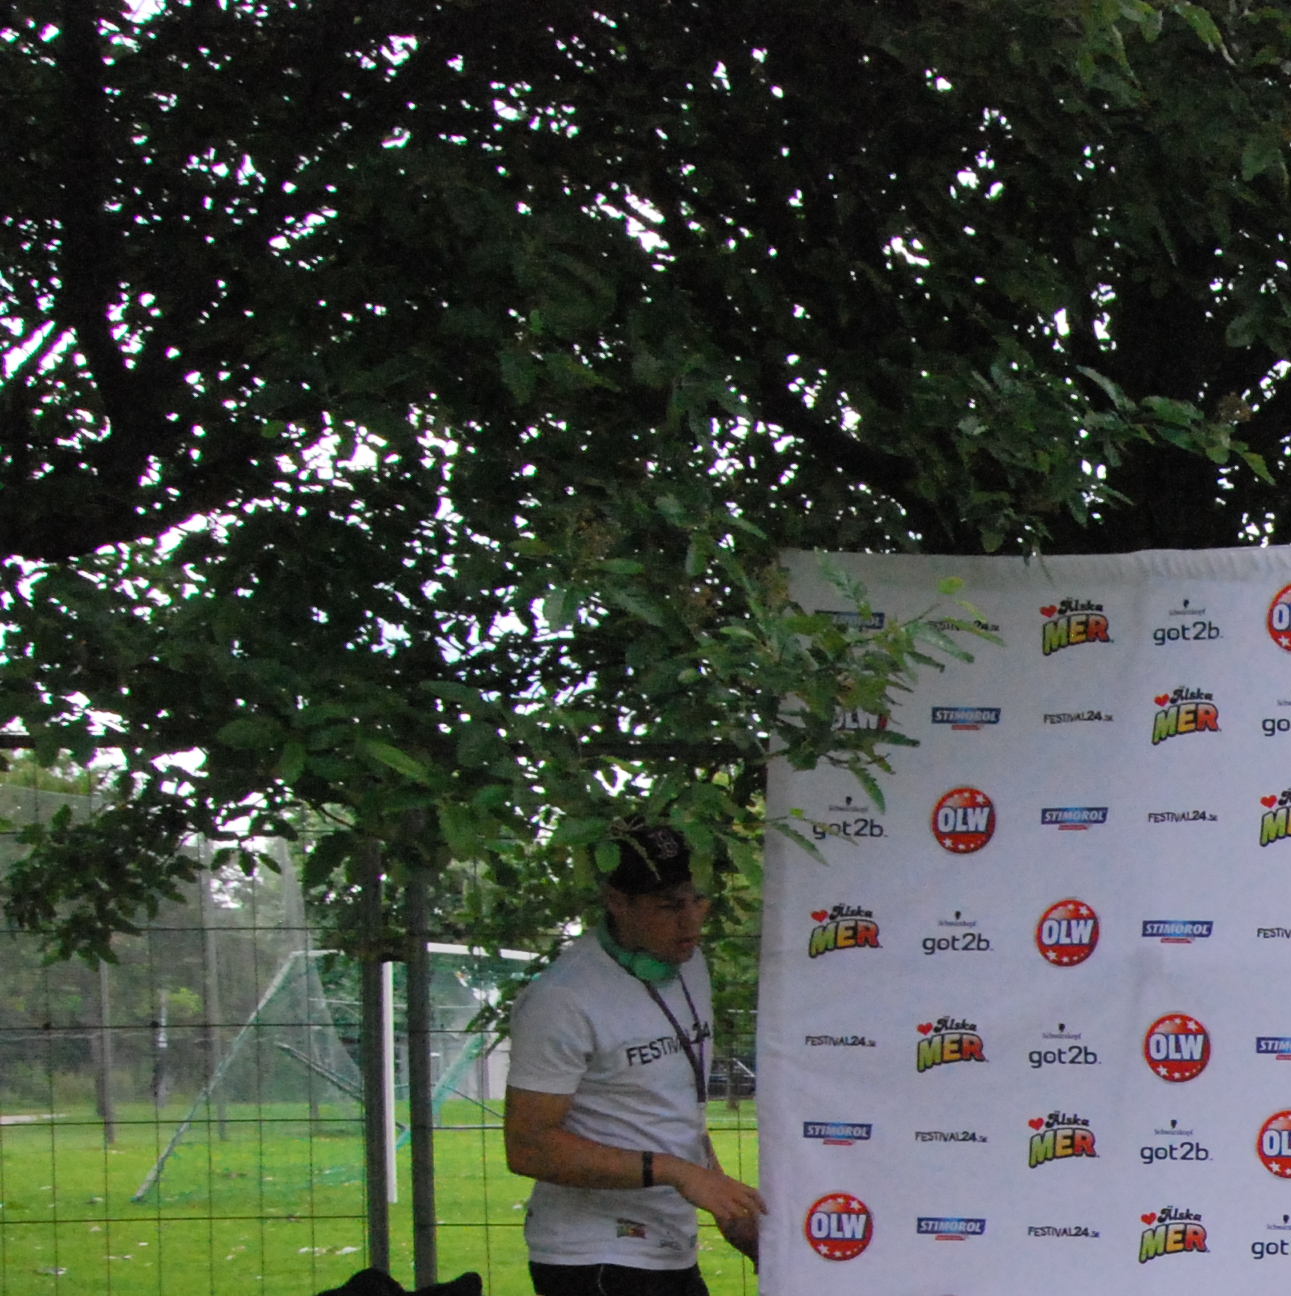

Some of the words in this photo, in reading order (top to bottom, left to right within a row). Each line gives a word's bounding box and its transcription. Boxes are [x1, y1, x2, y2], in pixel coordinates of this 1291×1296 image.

[1040, 614, 1111, 657] MER
[1153, 622, 1224, 647] got2b
[934, 709, 999, 724] STIMOROL
[1151, 702, 1222, 747] MER
[936, 806, 991, 834] OLW
[1044, 809, 1106, 824] STIMOROL
[808, 919, 879, 960] MER
[922, 931, 993, 956] got2b
[1040, 918, 1094, 946] OLW
[1145, 922, 1212, 937] STIMOROL
[916, 1032, 987, 1074] MER
[1028, 1045, 1099, 1070] got2b
[1149, 1033, 1205, 1061] OLW
[806, 1123, 871, 1138] STIMOROL
[1028, 1127, 1099, 1170] MER
[1140, 1140, 1211, 1165] got2b
[809, 1212, 867, 1240] OLW
[919, 1219, 984, 1234] STIMOROL
[1138, 1221, 1209, 1265] MER
